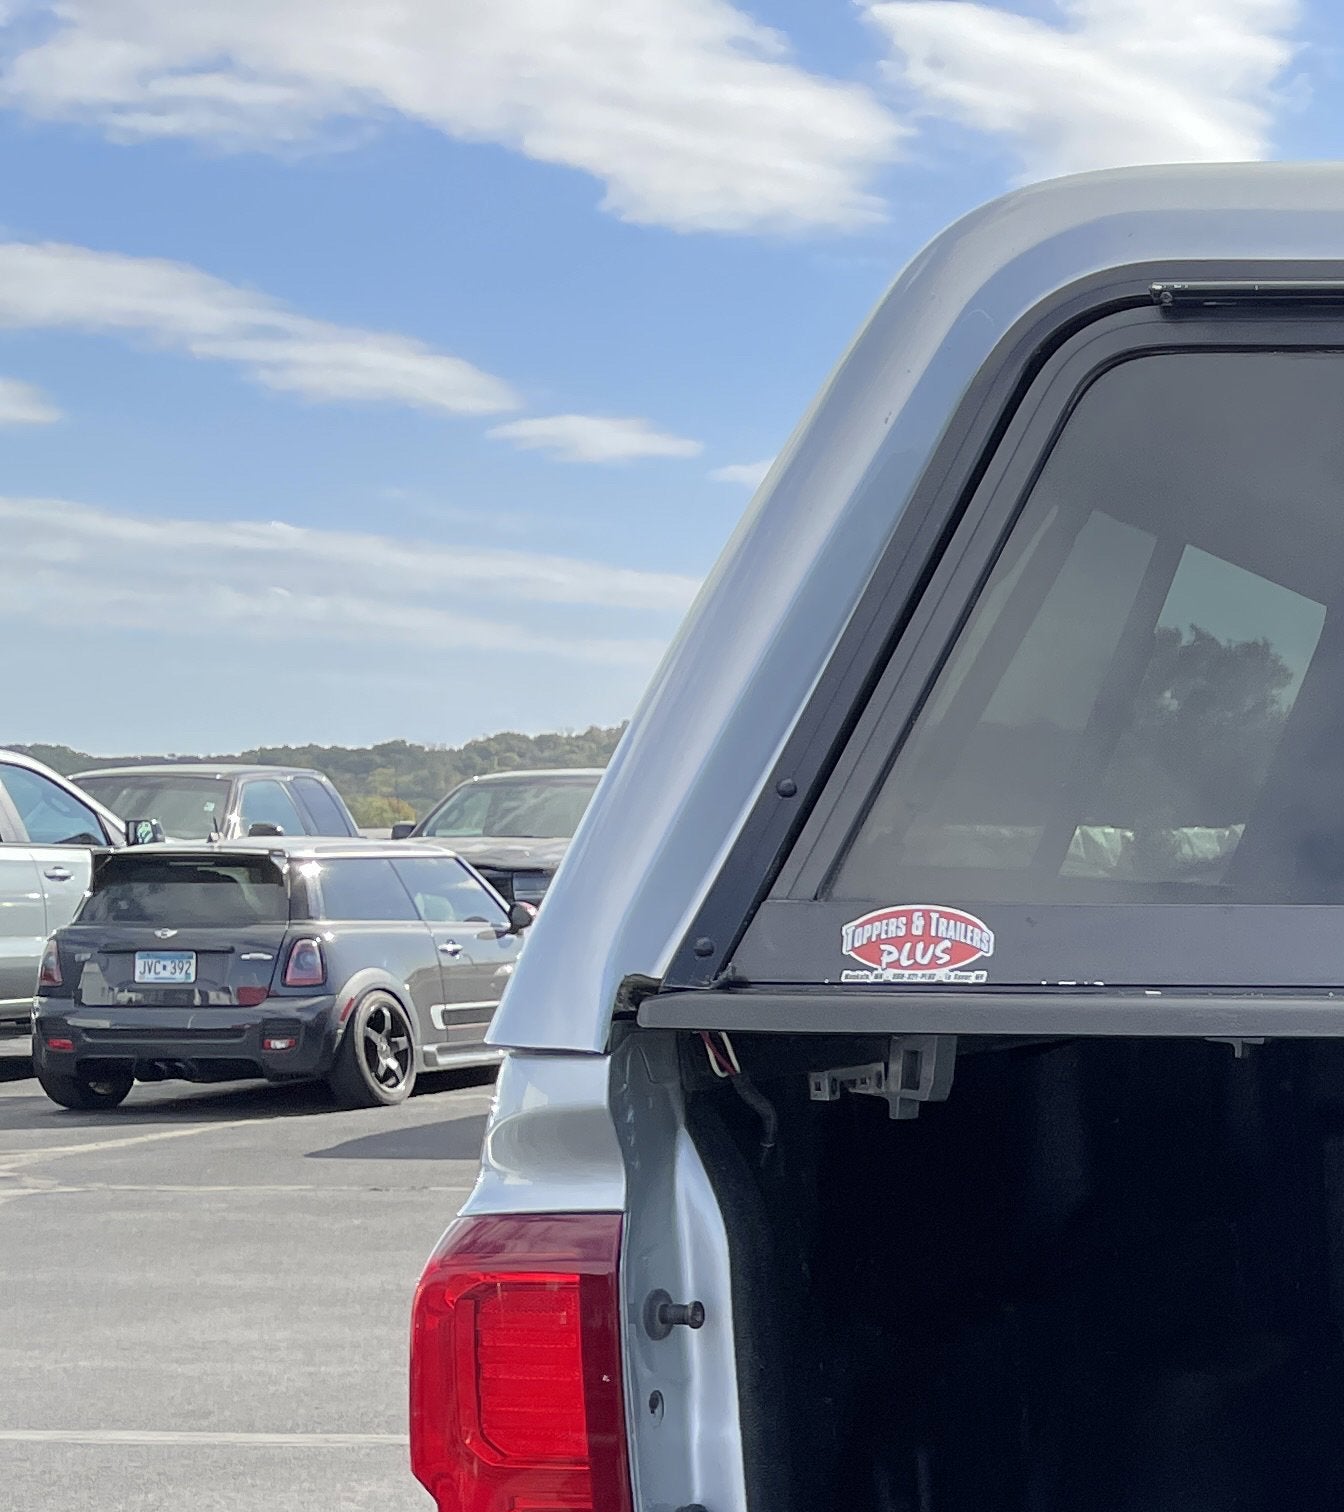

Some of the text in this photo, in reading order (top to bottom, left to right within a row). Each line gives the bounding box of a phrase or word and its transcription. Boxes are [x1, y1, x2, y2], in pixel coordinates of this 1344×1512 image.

[845, 911, 991, 953] TOPPERS & TRAILERS
[139, 960, 192, 976] JVC 392
[879, 939, 952, 969] PLUS
